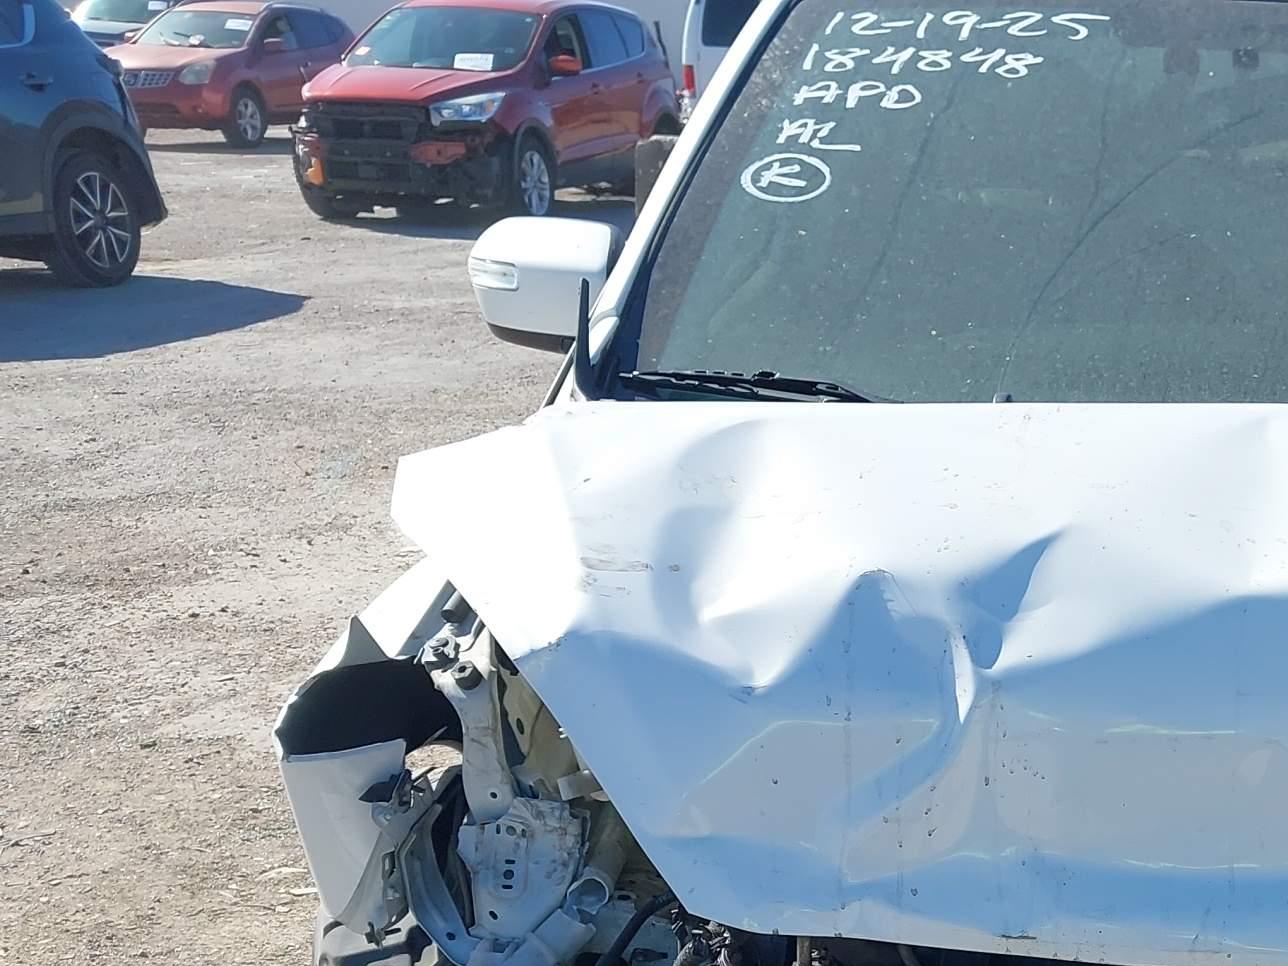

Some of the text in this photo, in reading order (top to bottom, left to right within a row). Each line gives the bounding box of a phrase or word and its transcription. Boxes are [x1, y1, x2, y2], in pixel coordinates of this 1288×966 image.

[825, 11, 1111, 41] 12-19-25
[802, 43, 1044, 78] 184848
[792, 80, 922, 109] APD
